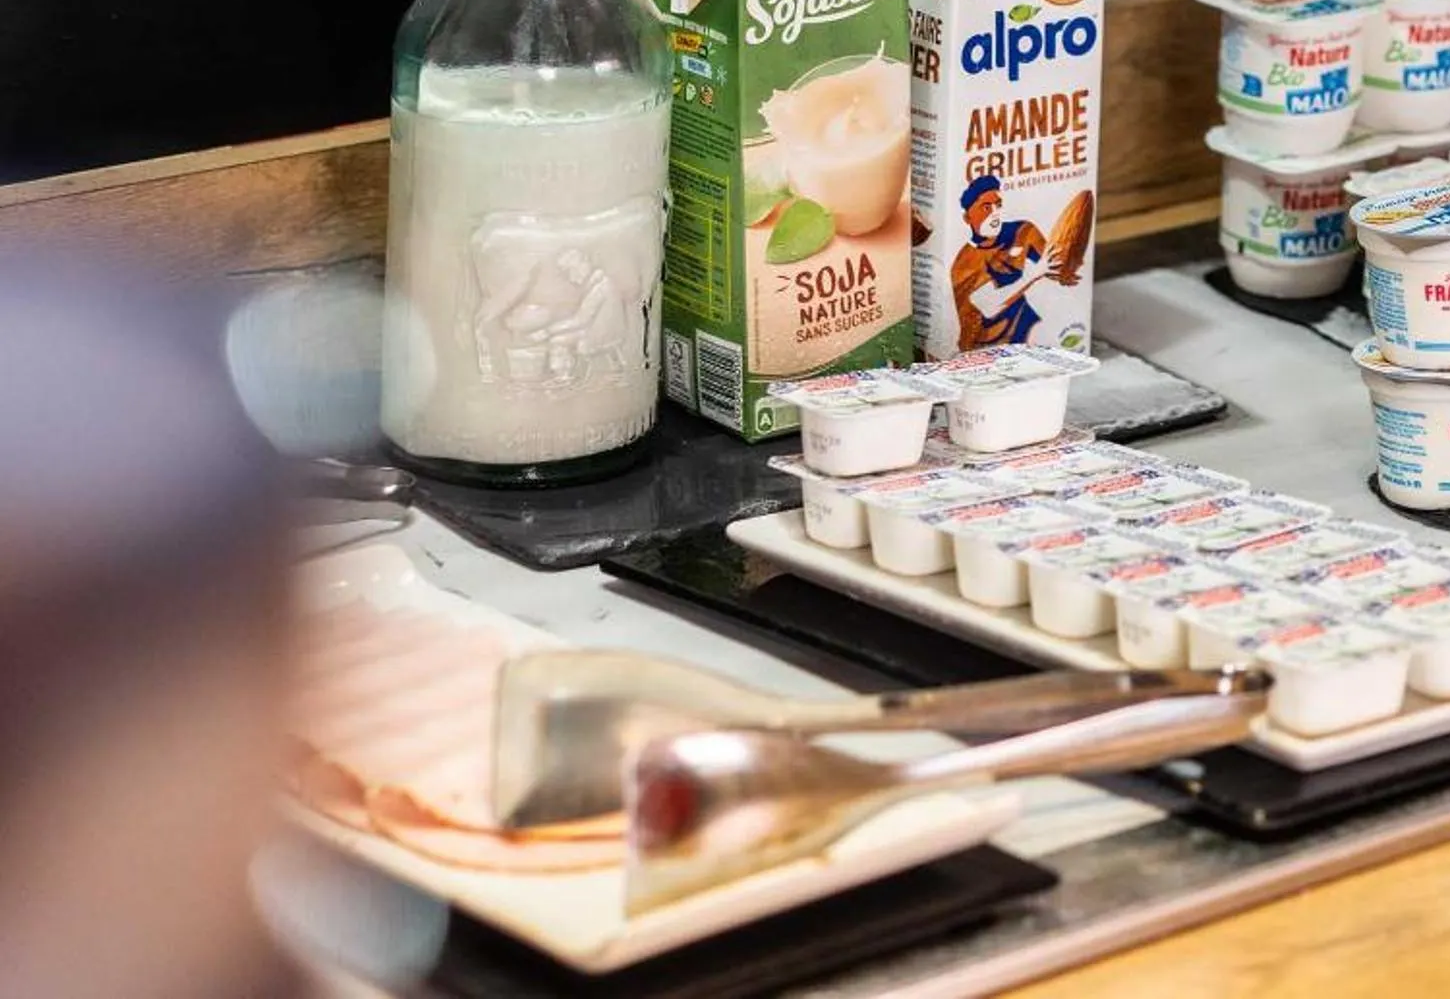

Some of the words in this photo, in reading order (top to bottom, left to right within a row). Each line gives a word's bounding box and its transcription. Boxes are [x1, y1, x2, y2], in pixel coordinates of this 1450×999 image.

[914, 10, 942, 45] FAIRE
[961, 10, 1097, 82] alpro
[1292, 86, 1347, 113] MALO
[966, 90, 1089, 152] AMANDE
[966, 136, 1087, 182] GRILLÉE
[1285, 231, 1343, 256] MALO
[795, 252, 877, 303] SOJA
[796, 323, 832, 343] SANS
[834, 305, 884, 332] SUCRES
[800, 286, 877, 325] NATURE
[760, 412, 772, 426] A
